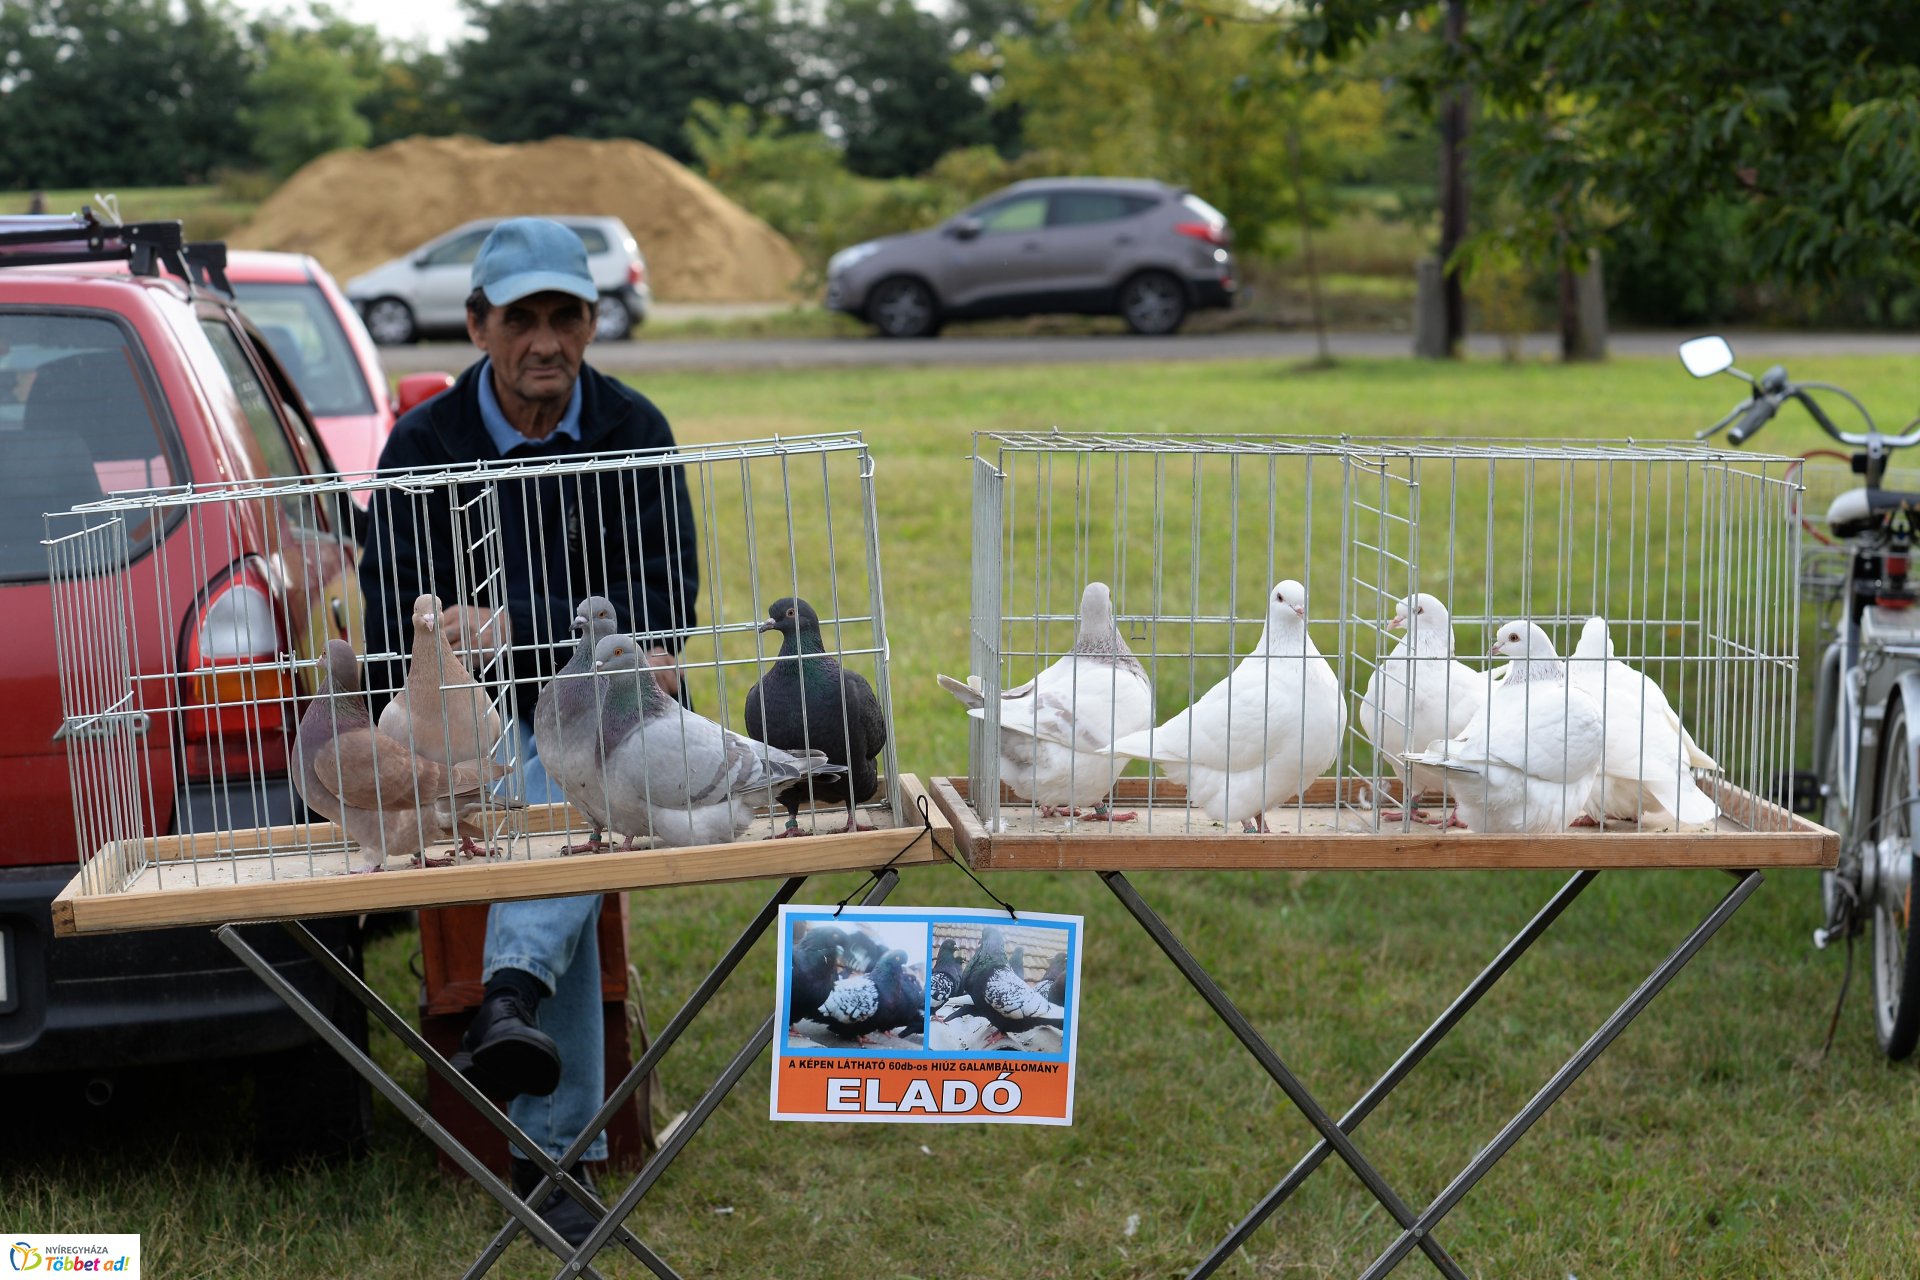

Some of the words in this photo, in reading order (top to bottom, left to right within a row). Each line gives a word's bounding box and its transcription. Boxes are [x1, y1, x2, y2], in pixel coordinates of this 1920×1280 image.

[788, 1060, 796, 1069] A
[799, 1058, 834, 1069] KÉPEN
[837, 1058, 886, 1070] LÁTHATÓ
[888, 1061, 928, 1071] 60db-os
[931, 1061, 957, 1072] HIÚZ
[959, 1061, 1059, 1074] GALAMBÁLLOMÁNY
[826, 1071, 1023, 1114] ELADÓ
